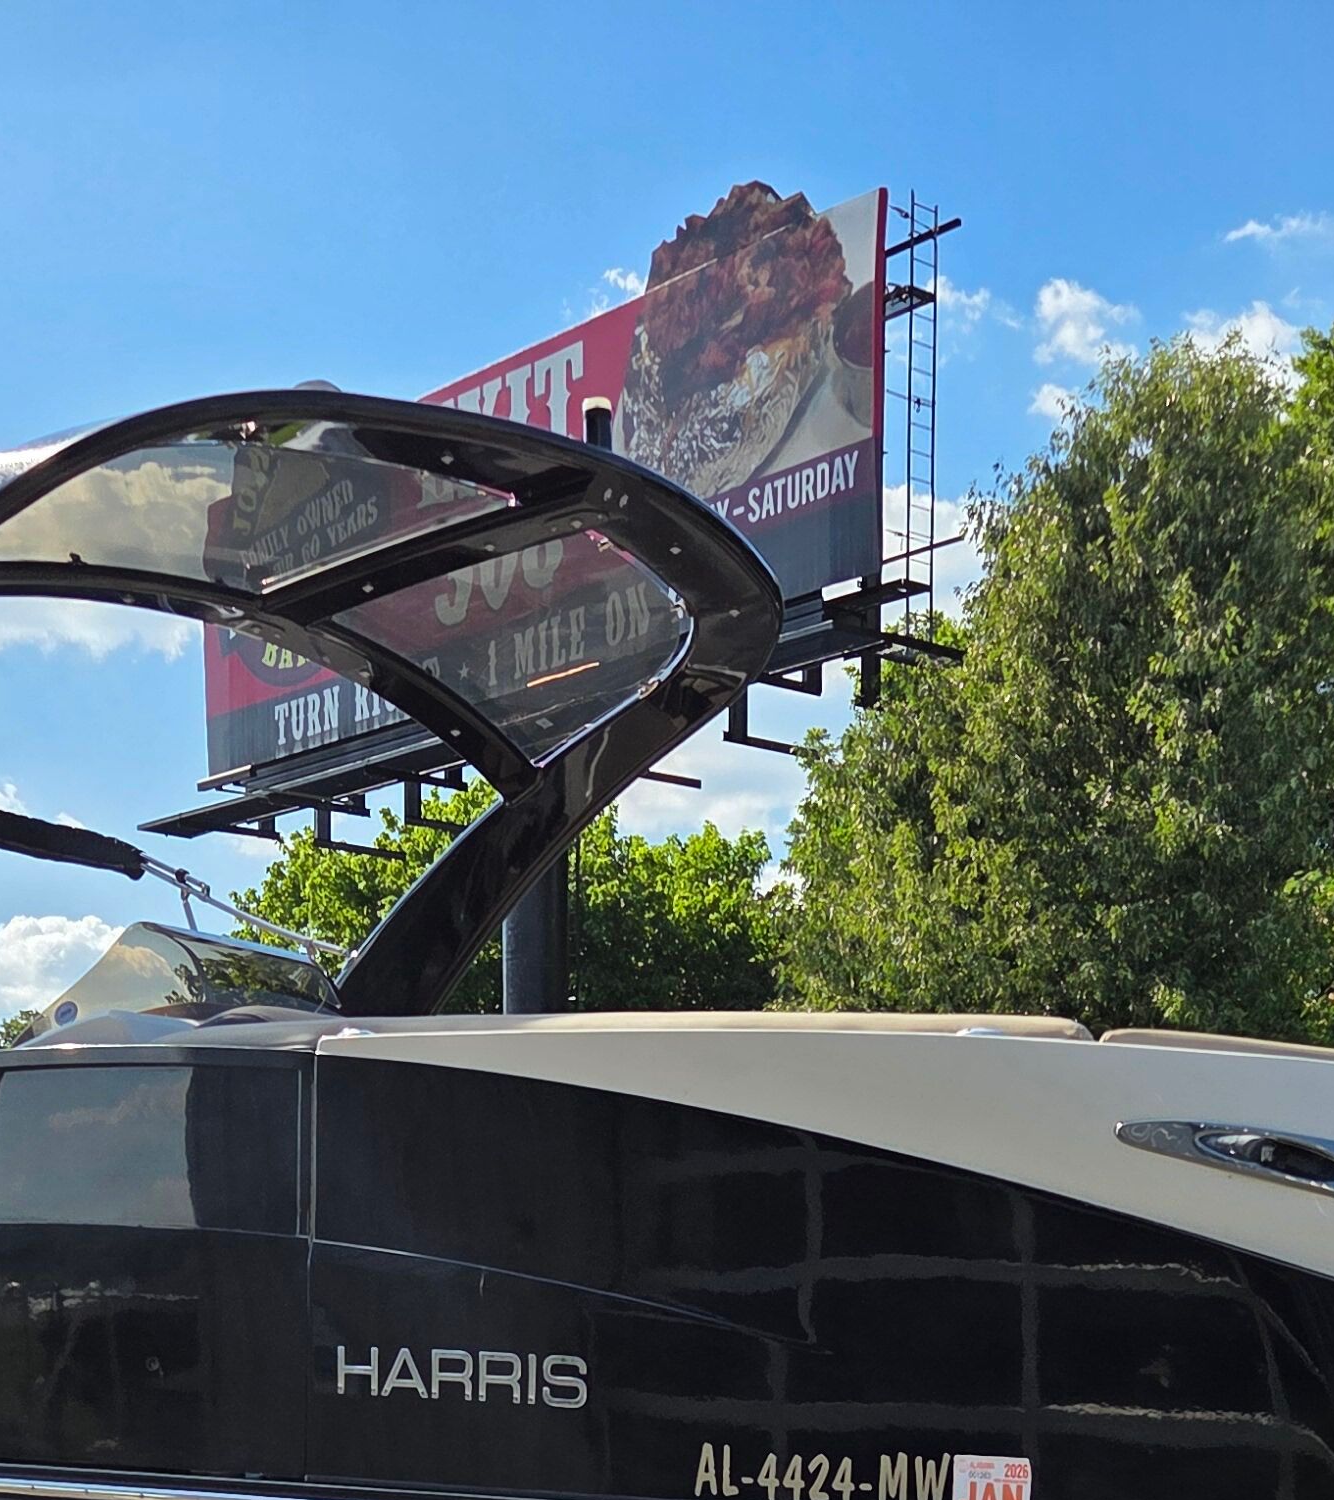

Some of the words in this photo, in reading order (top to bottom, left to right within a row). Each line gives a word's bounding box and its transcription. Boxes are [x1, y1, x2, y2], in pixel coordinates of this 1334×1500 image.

[297, 479, 354, 536] OWNED
[302, 534, 321, 564] 60
[326, 497, 378, 548] YEARS
[274, 686, 340, 745] TURN
[514, 605, 585, 679] MILE
[605, 582, 650, 646] ON
[337, 1345, 587, 1409] HARRIS
[1004, 1463, 1029, 1479] 2026
